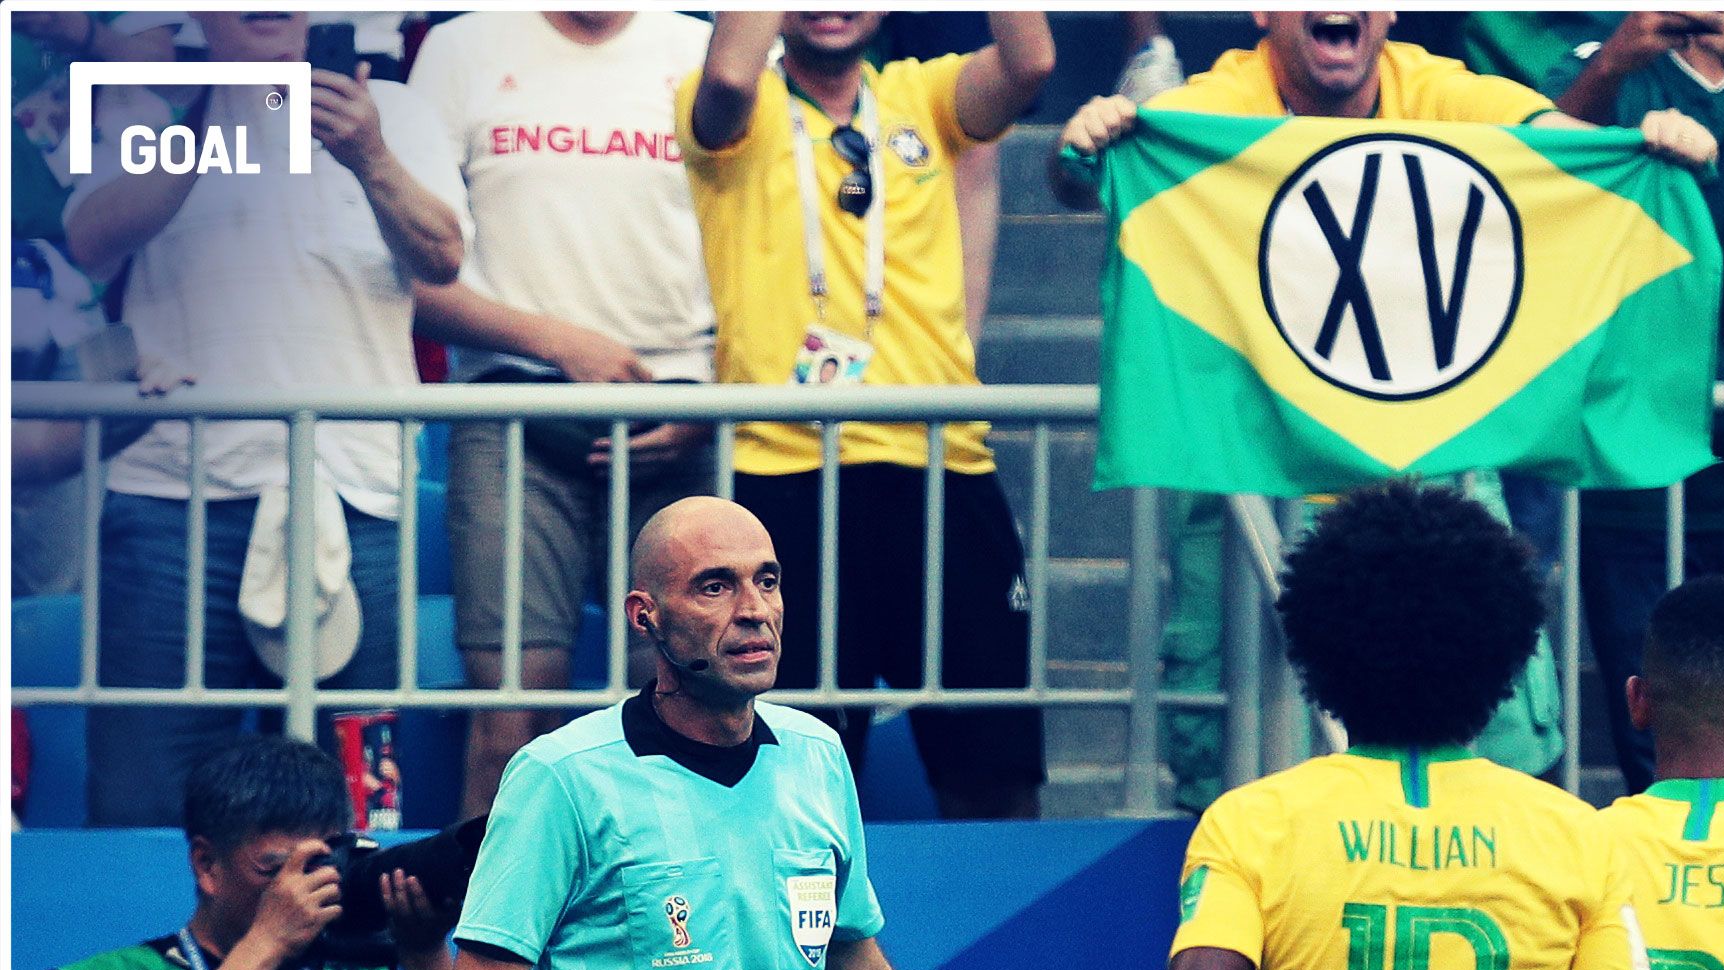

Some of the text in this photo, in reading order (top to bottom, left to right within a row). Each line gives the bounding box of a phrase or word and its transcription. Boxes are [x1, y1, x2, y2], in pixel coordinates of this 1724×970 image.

[491, 125, 685, 164] ENGLAND
[1302, 152, 1486, 382] XV
[1338, 820, 1497, 871] WILLIAN
[798, 910, 831, 929] FIFA
[652, 955, 690, 968] RUSSIA
